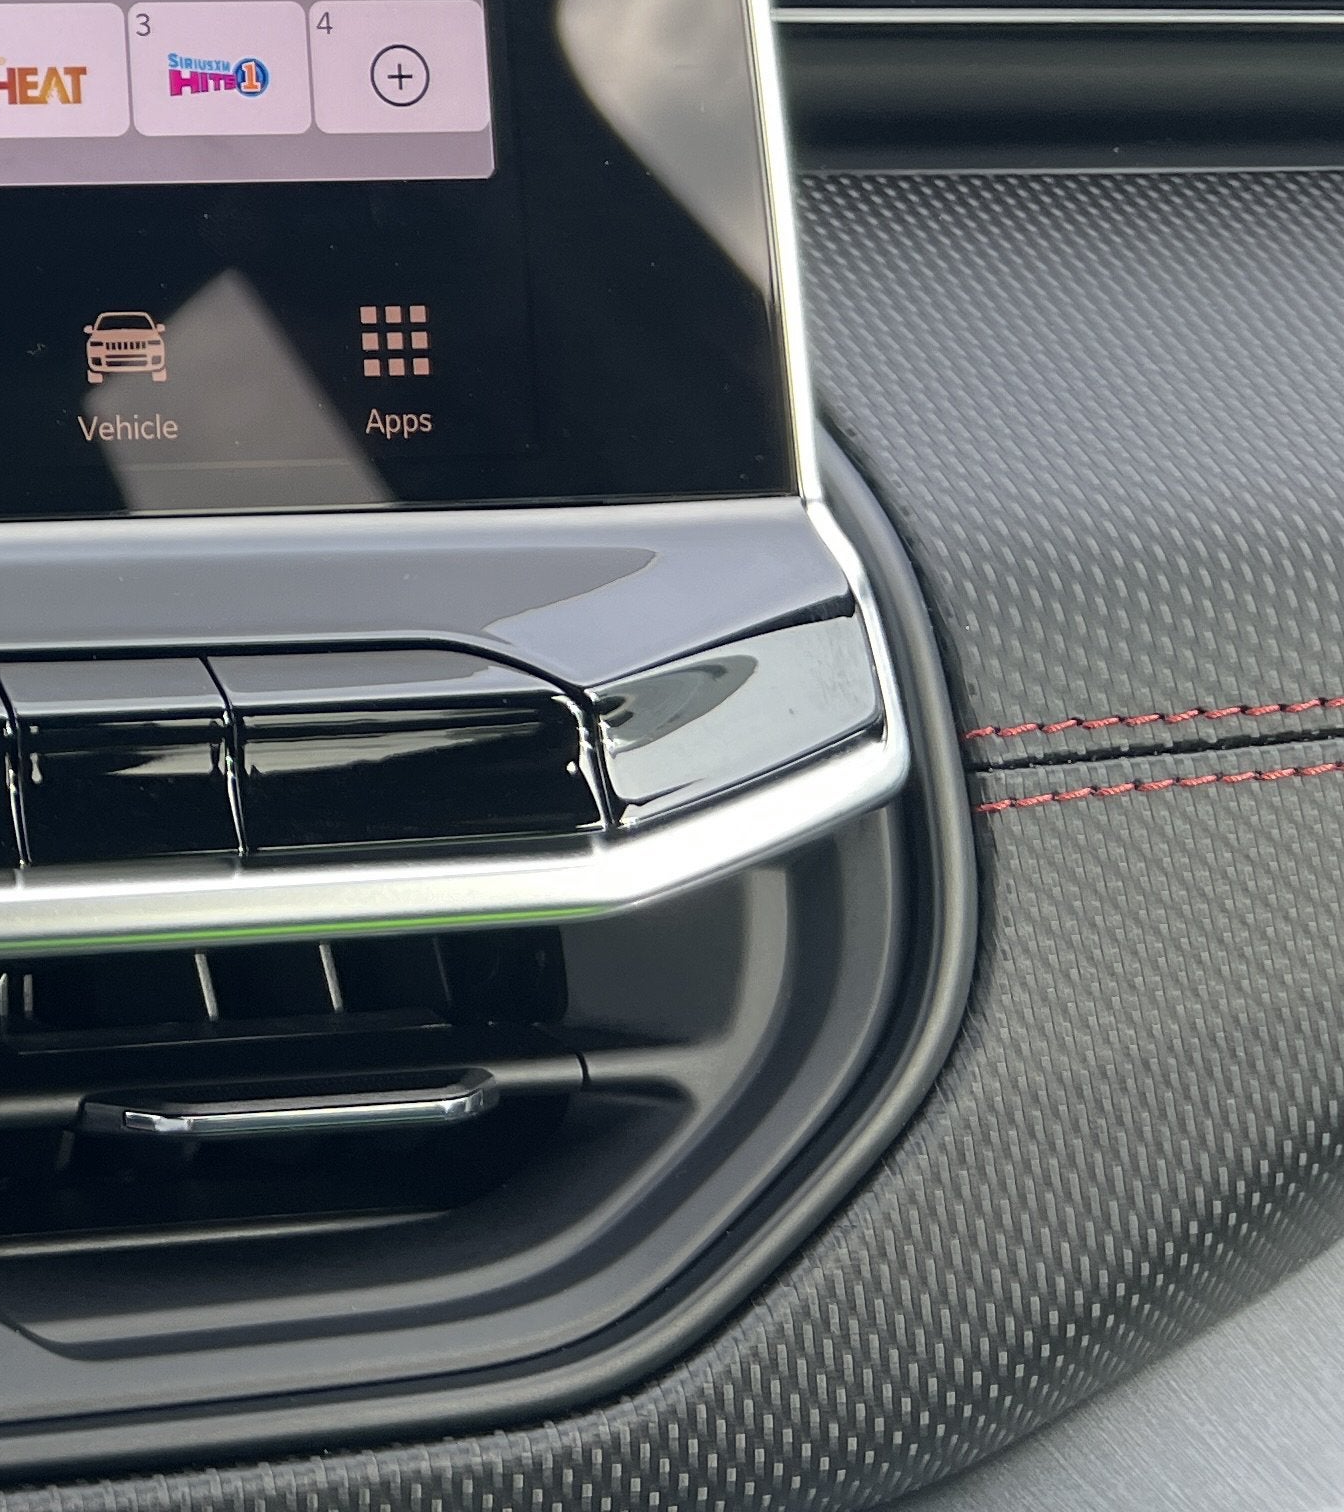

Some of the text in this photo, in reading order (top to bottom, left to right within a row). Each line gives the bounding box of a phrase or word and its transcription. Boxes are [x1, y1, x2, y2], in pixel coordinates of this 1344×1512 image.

[136, 13, 151, 37] 3
[316, 12, 333, 35] 4
[169, 61, 262, 96] HITS 1
[77, 414, 179, 442] Vehicle
[365, 407, 433, 437] Apps
